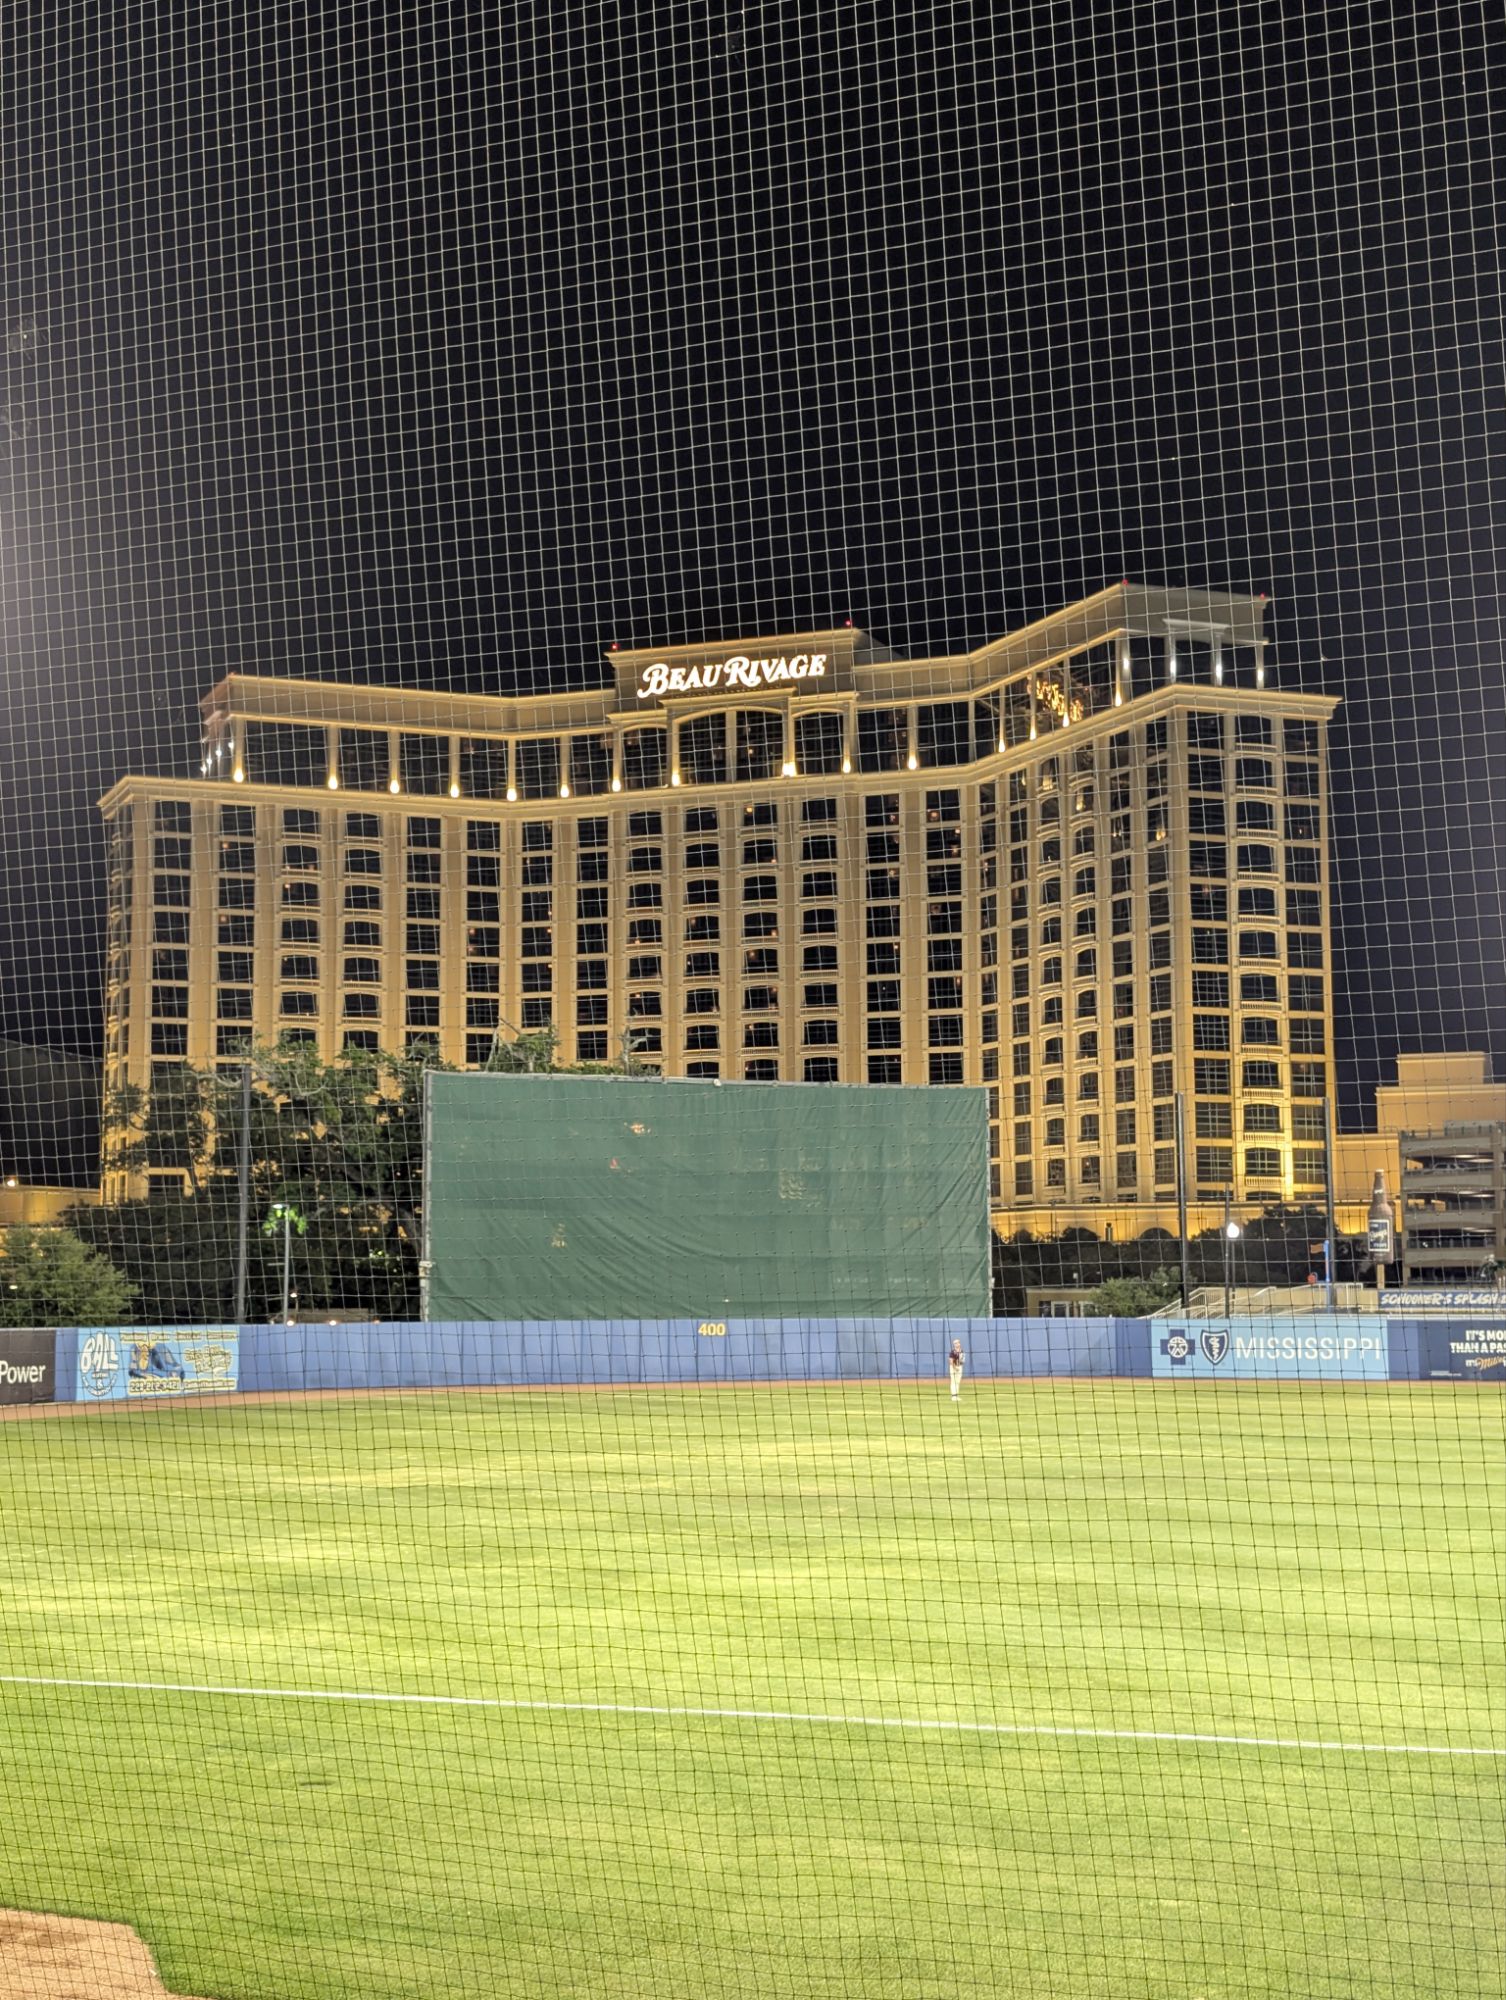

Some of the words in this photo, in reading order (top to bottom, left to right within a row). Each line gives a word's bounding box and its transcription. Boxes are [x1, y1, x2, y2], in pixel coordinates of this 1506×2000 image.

[1454, 1292, 1499, 1305] SPLASH
[698, 1323, 726, 1336] 400
[1465, 1330, 1486, 1341] IT'S
[81, 1331, 119, 1374] BALL
[1235, 1337, 1380, 1360] MISSISSIPPI
[1450, 1342, 1479, 1353] THAN
[1480, 1342, 1489, 1353] A
[0, 1360, 46, 1384] Power
